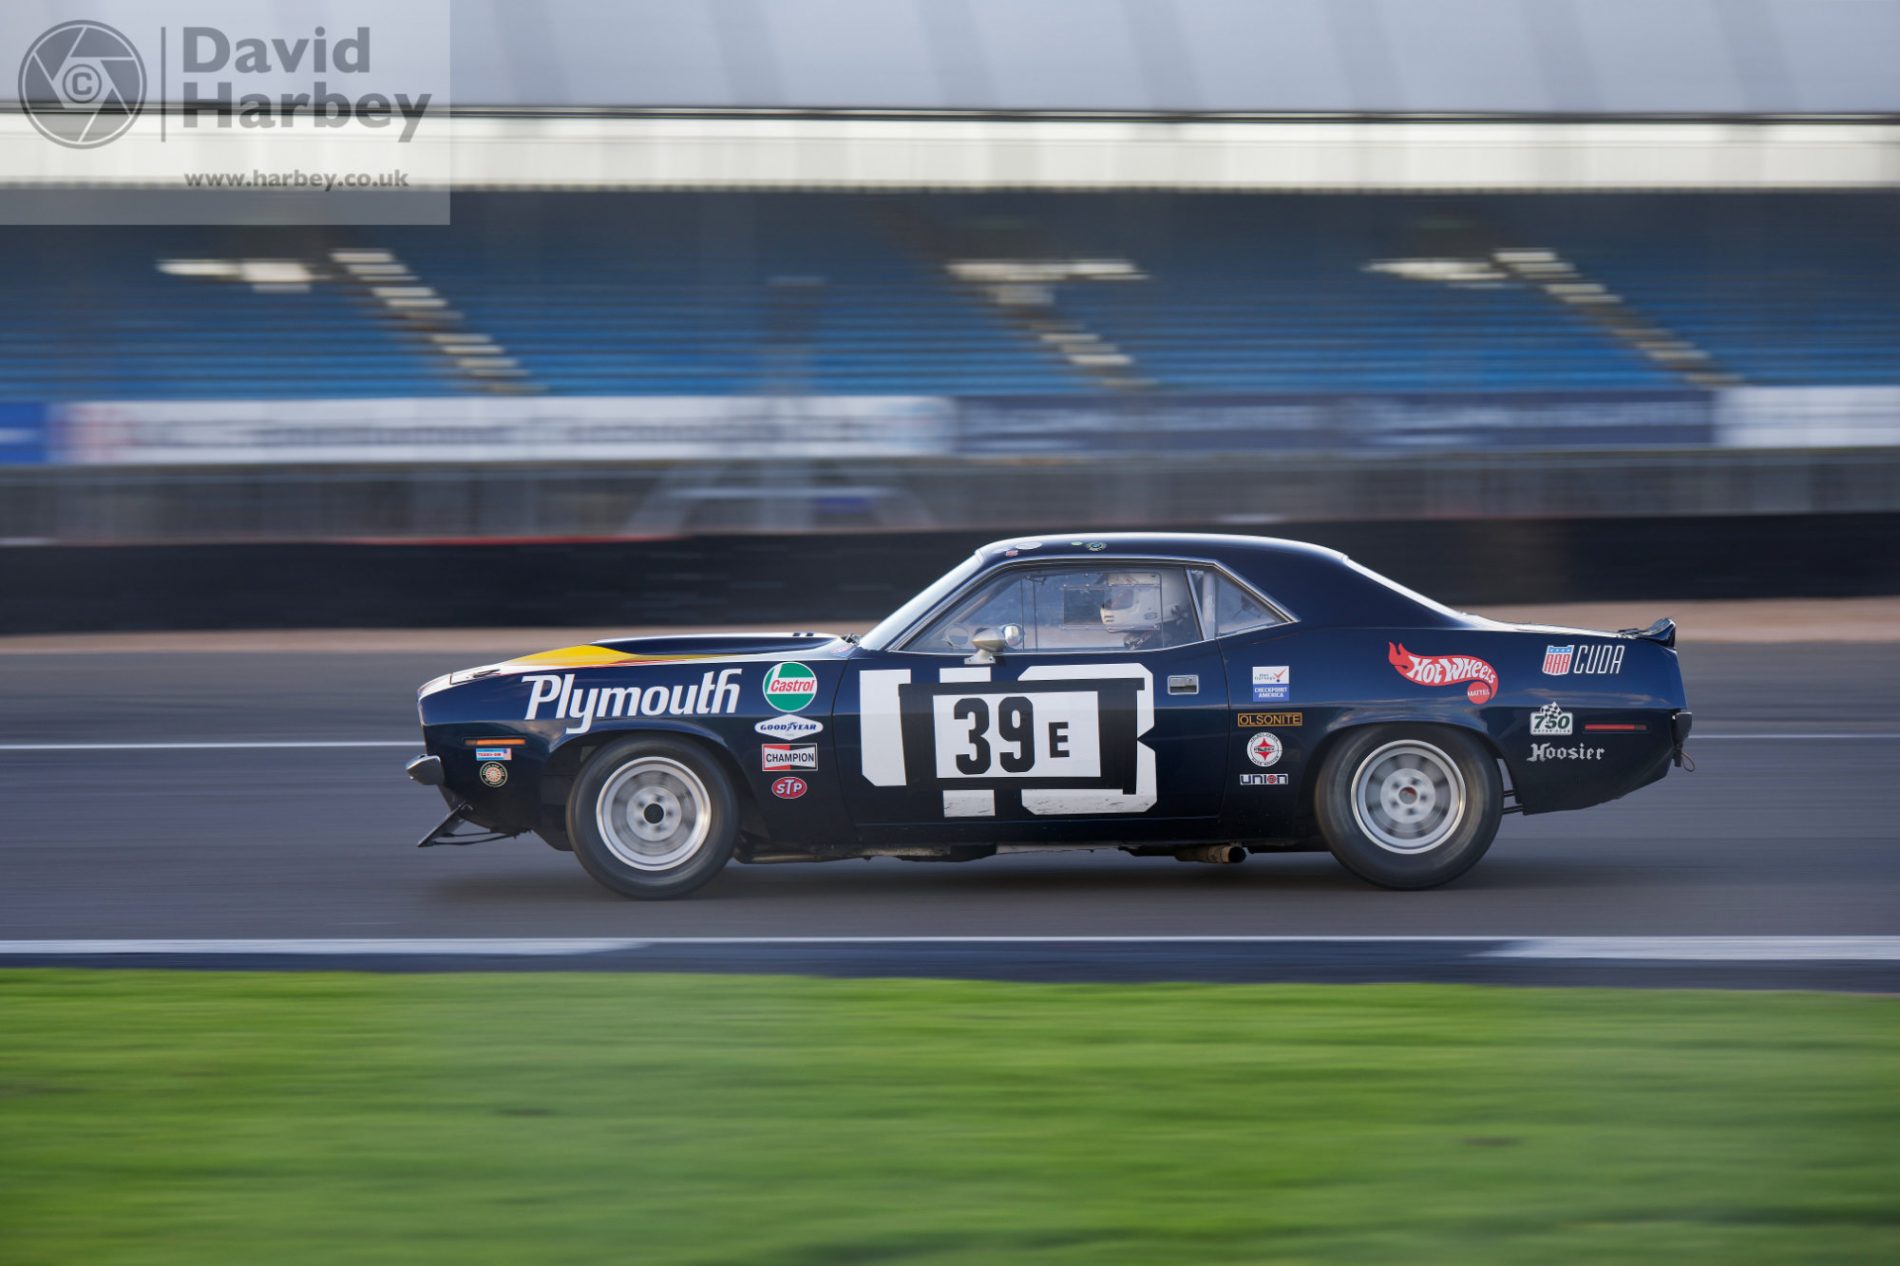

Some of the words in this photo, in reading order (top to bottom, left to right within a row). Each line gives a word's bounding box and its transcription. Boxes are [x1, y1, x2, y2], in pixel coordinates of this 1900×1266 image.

[1573, 644, 1626, 675] CUDA
[770, 679, 815, 693] Castrol
[1467, 688, 1490, 697] MATTEL
[521, 668, 743, 735] Plymouth
[760, 721, 817, 732] GOODYEAR
[1240, 714, 1301, 726] OLSONITE
[1534, 715, 1571, 729] 750
[953, 696, 1036, 775] 39
[1048, 721, 1071, 759] E
[765, 752, 815, 763] CHAMPION
[1526, 742, 1606, 762] Hoosier
[776, 779, 803, 795] STP
